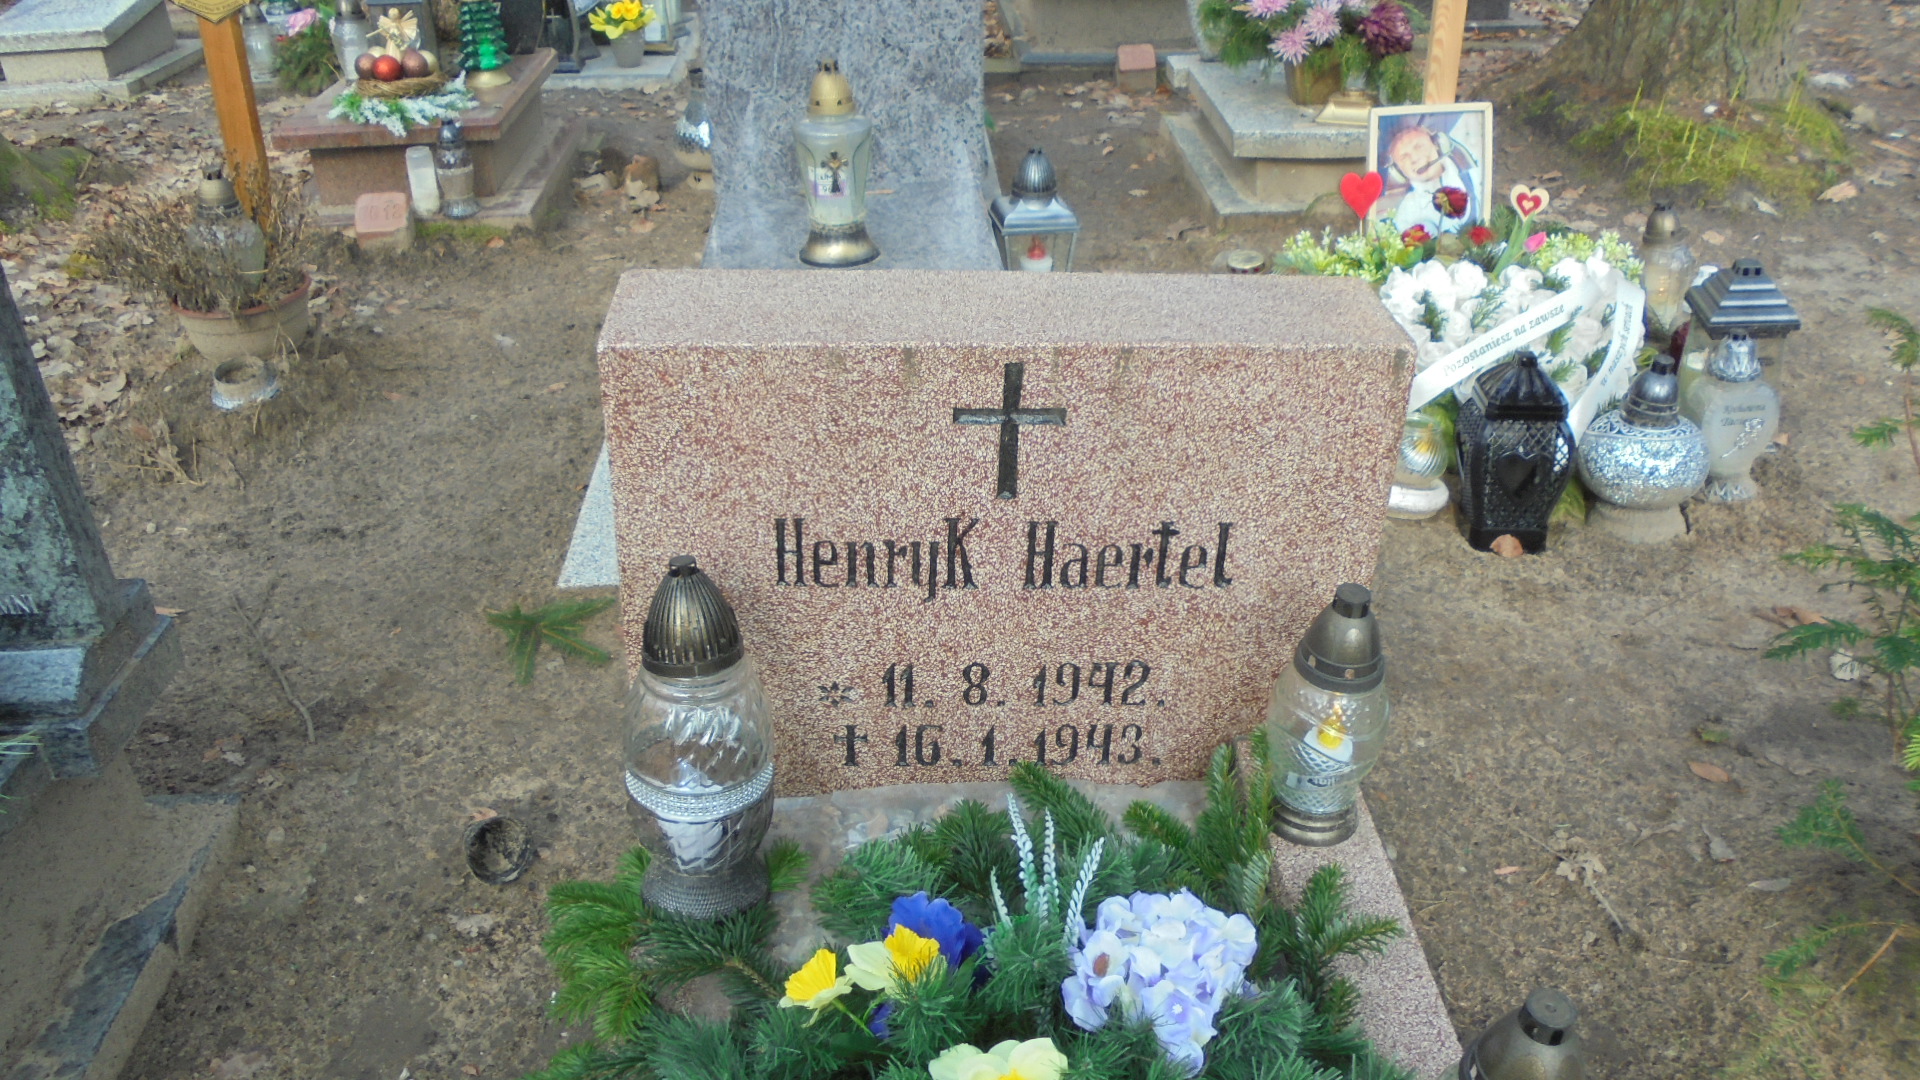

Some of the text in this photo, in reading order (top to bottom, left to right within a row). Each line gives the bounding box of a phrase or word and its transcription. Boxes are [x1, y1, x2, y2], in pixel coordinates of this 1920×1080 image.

[1443, 304, 1566, 377] Pozostaniesz na zawsze
[1024, 520, 1234, 590] Haertel
